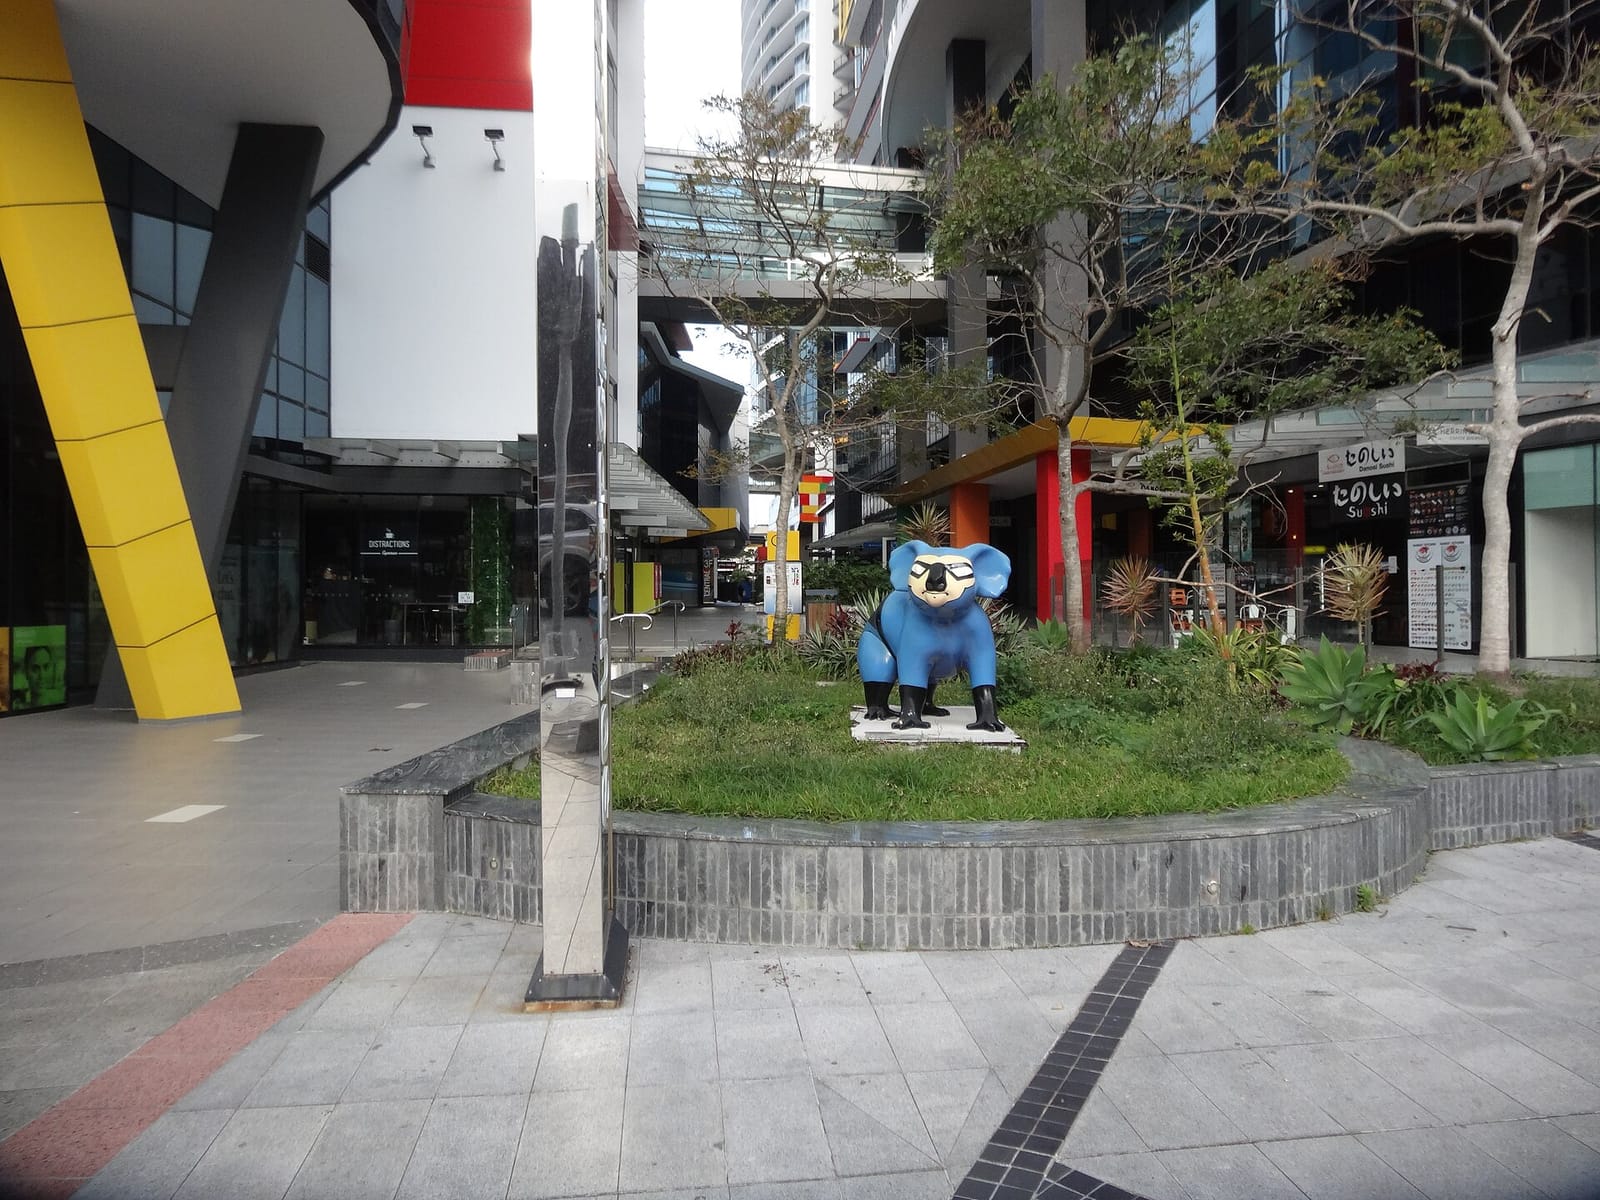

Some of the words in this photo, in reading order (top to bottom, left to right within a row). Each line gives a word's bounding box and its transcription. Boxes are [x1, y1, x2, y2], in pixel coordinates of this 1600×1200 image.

[1345, 446, 1395, 466] たのしい
[1333, 481, 1403, 507] たのしい
[369, 540, 410, 548] DISTRACTIONS
